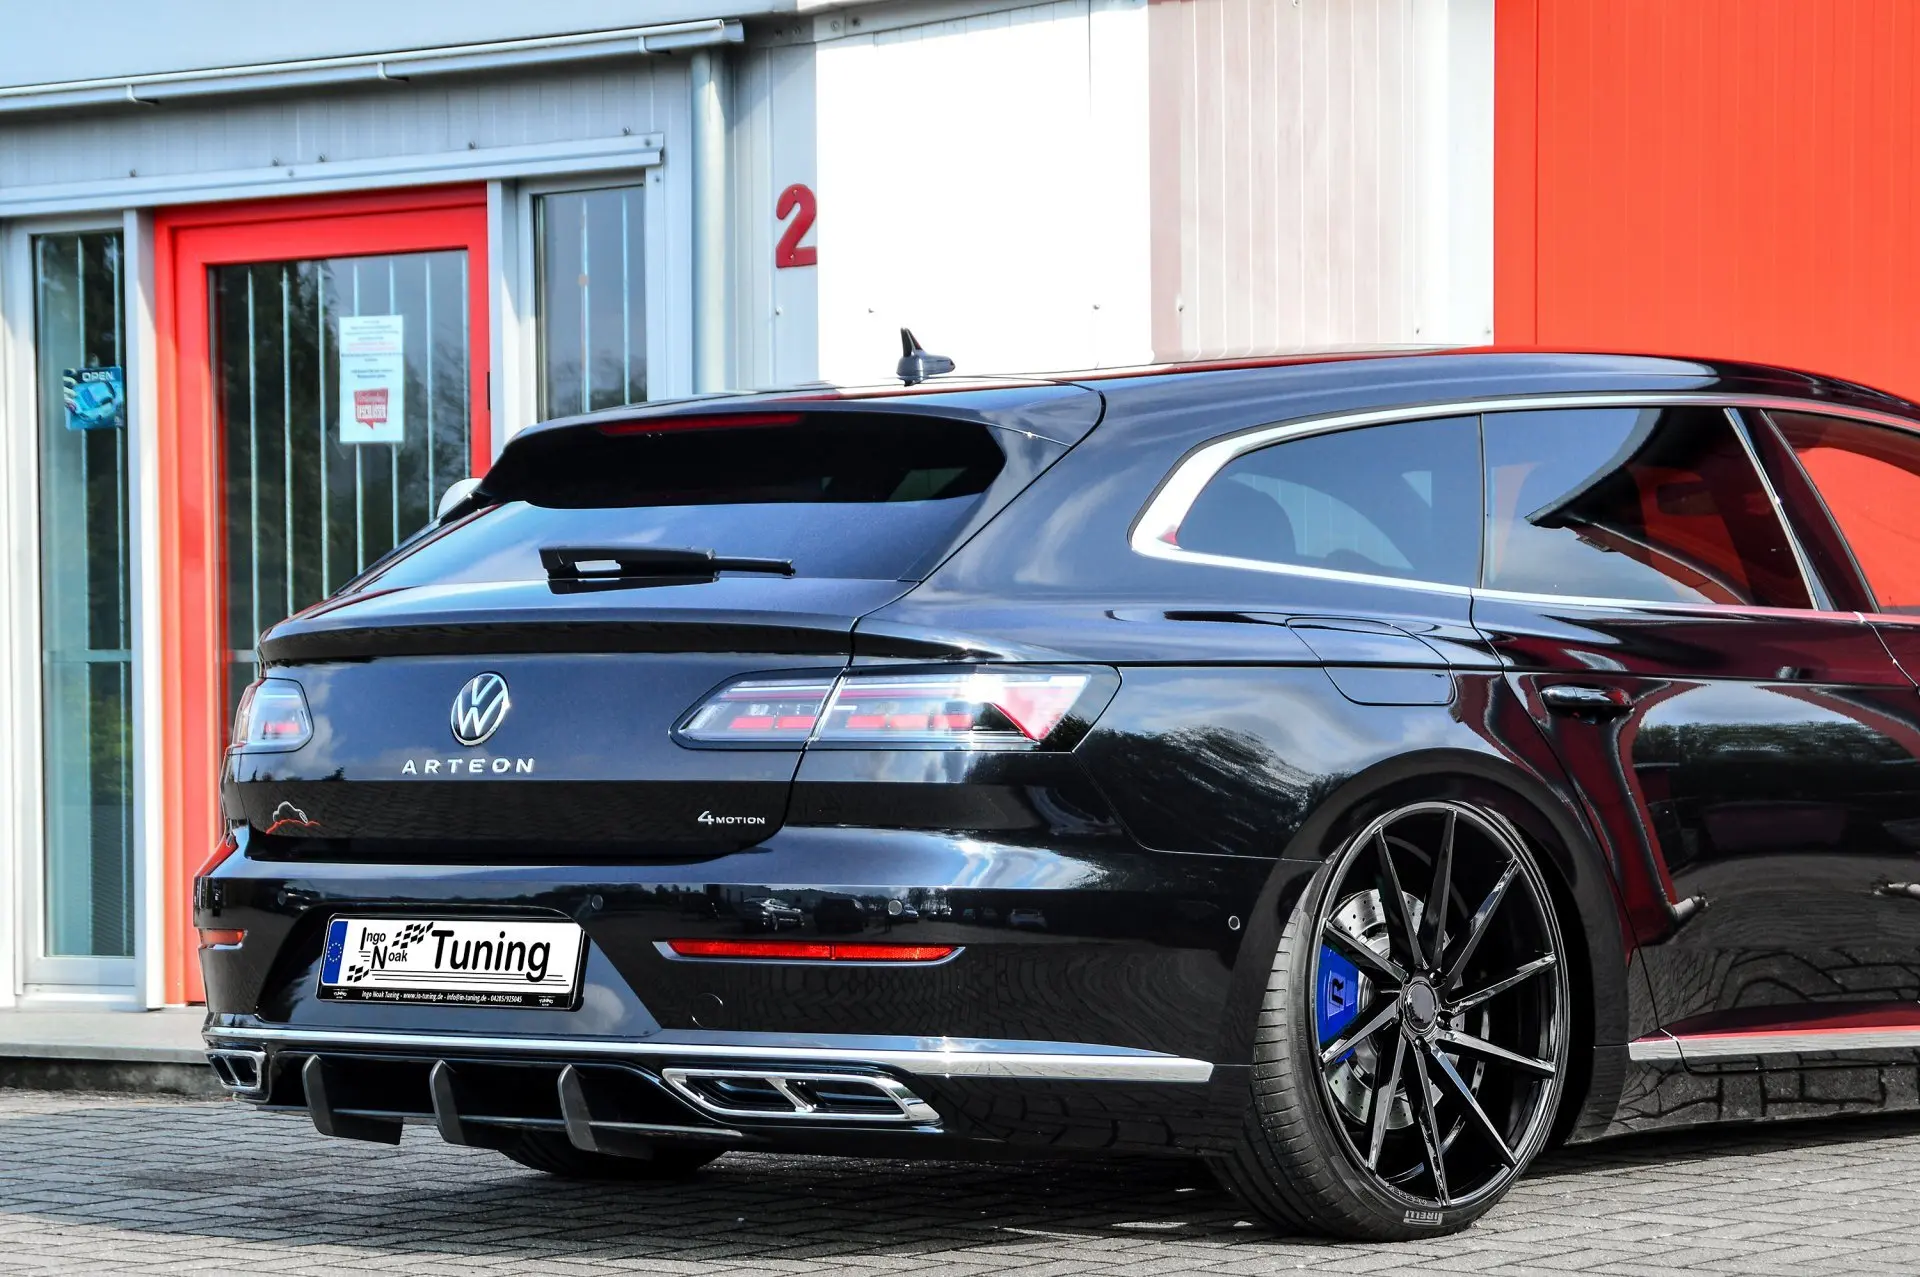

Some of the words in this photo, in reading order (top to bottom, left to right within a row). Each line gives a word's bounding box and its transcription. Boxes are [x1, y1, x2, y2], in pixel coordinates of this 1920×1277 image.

[776, 183, 817, 268] 2
[82, 371, 115, 382] OPEN
[401, 758, 535, 774] ARTEON
[697, 810, 766, 825] 4MOTION
[360, 927, 387, 951] Ingo
[371, 945, 408, 969] Noak
[431, 930, 551, 982] Tuning
[1403, 1210, 1443, 1225] PIRELLI
